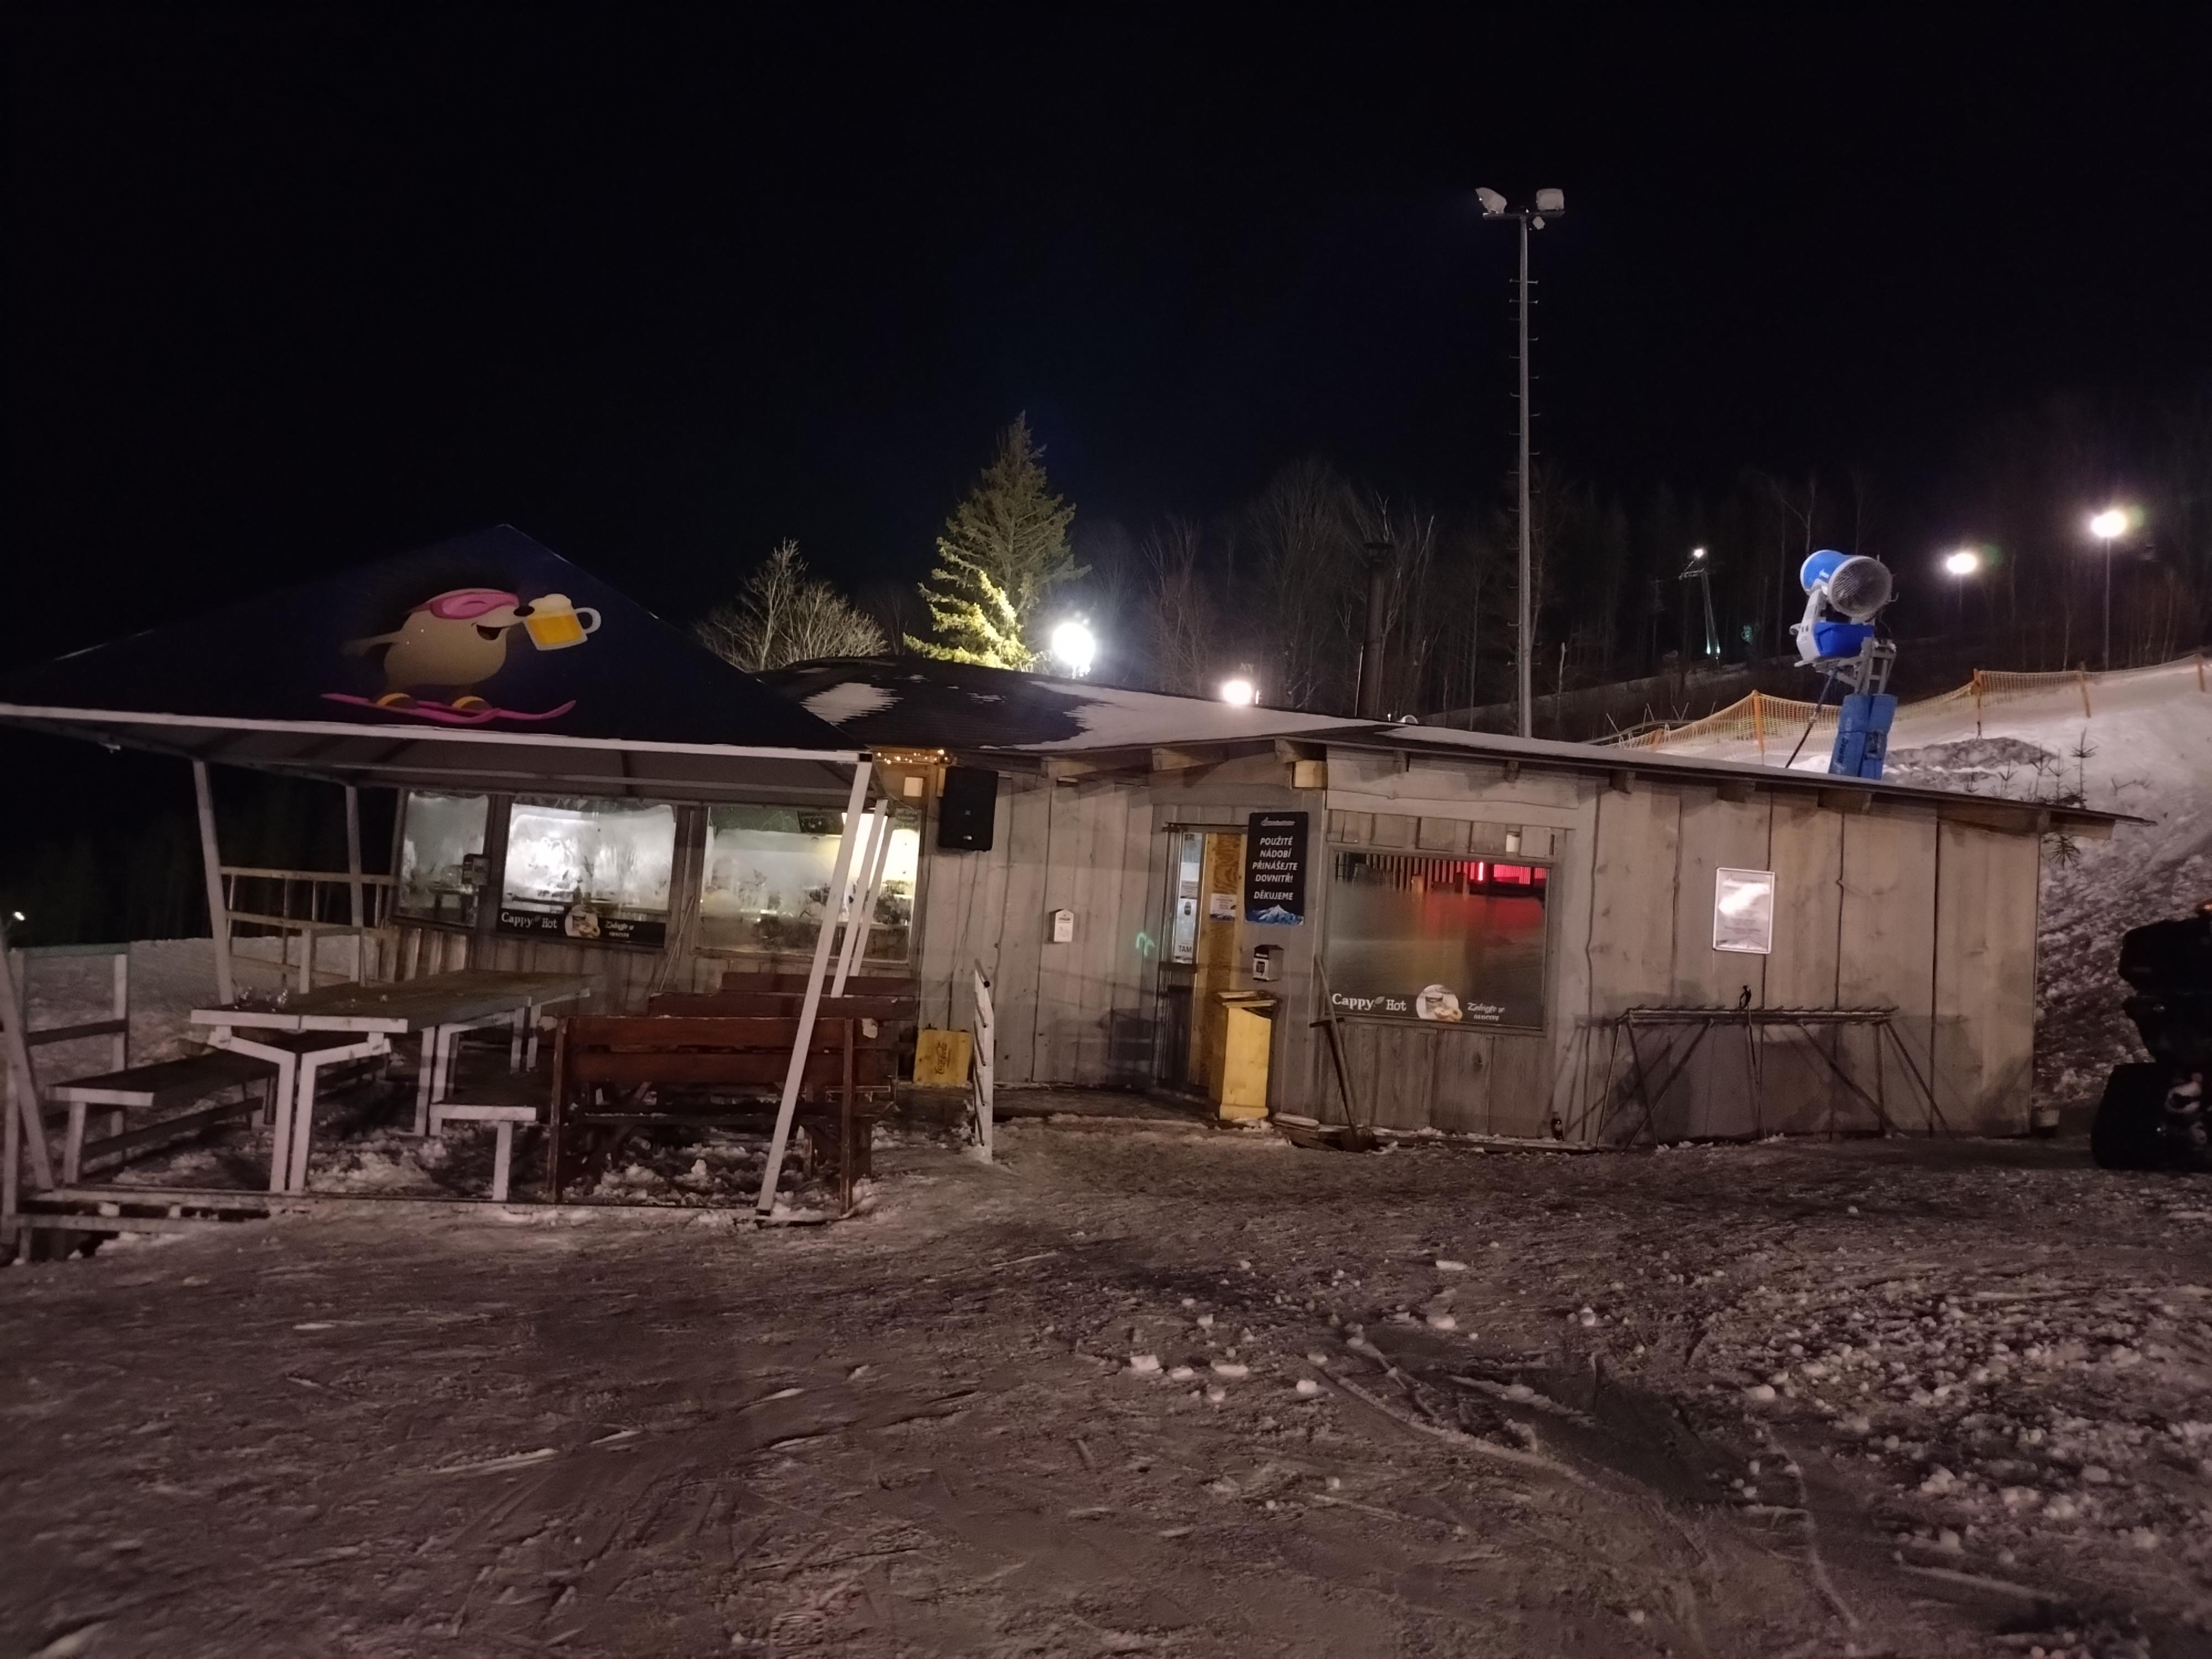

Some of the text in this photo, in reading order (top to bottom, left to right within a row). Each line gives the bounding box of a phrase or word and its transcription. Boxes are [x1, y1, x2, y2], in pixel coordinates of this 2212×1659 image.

[1260, 836, 1293, 846] POUŽITÉ
[1260, 848, 1292, 858] NÁDOBÍ
[1253, 860, 1298, 870] PŘINÁŠEJTE
[1255, 873, 1293, 883] DOVNITŘ!
[1254, 889, 1293, 901] DĚKUJEME
[502, 911, 557, 928] Cappy Hot
[1332, 993, 1407, 1011] Cappy Hot
